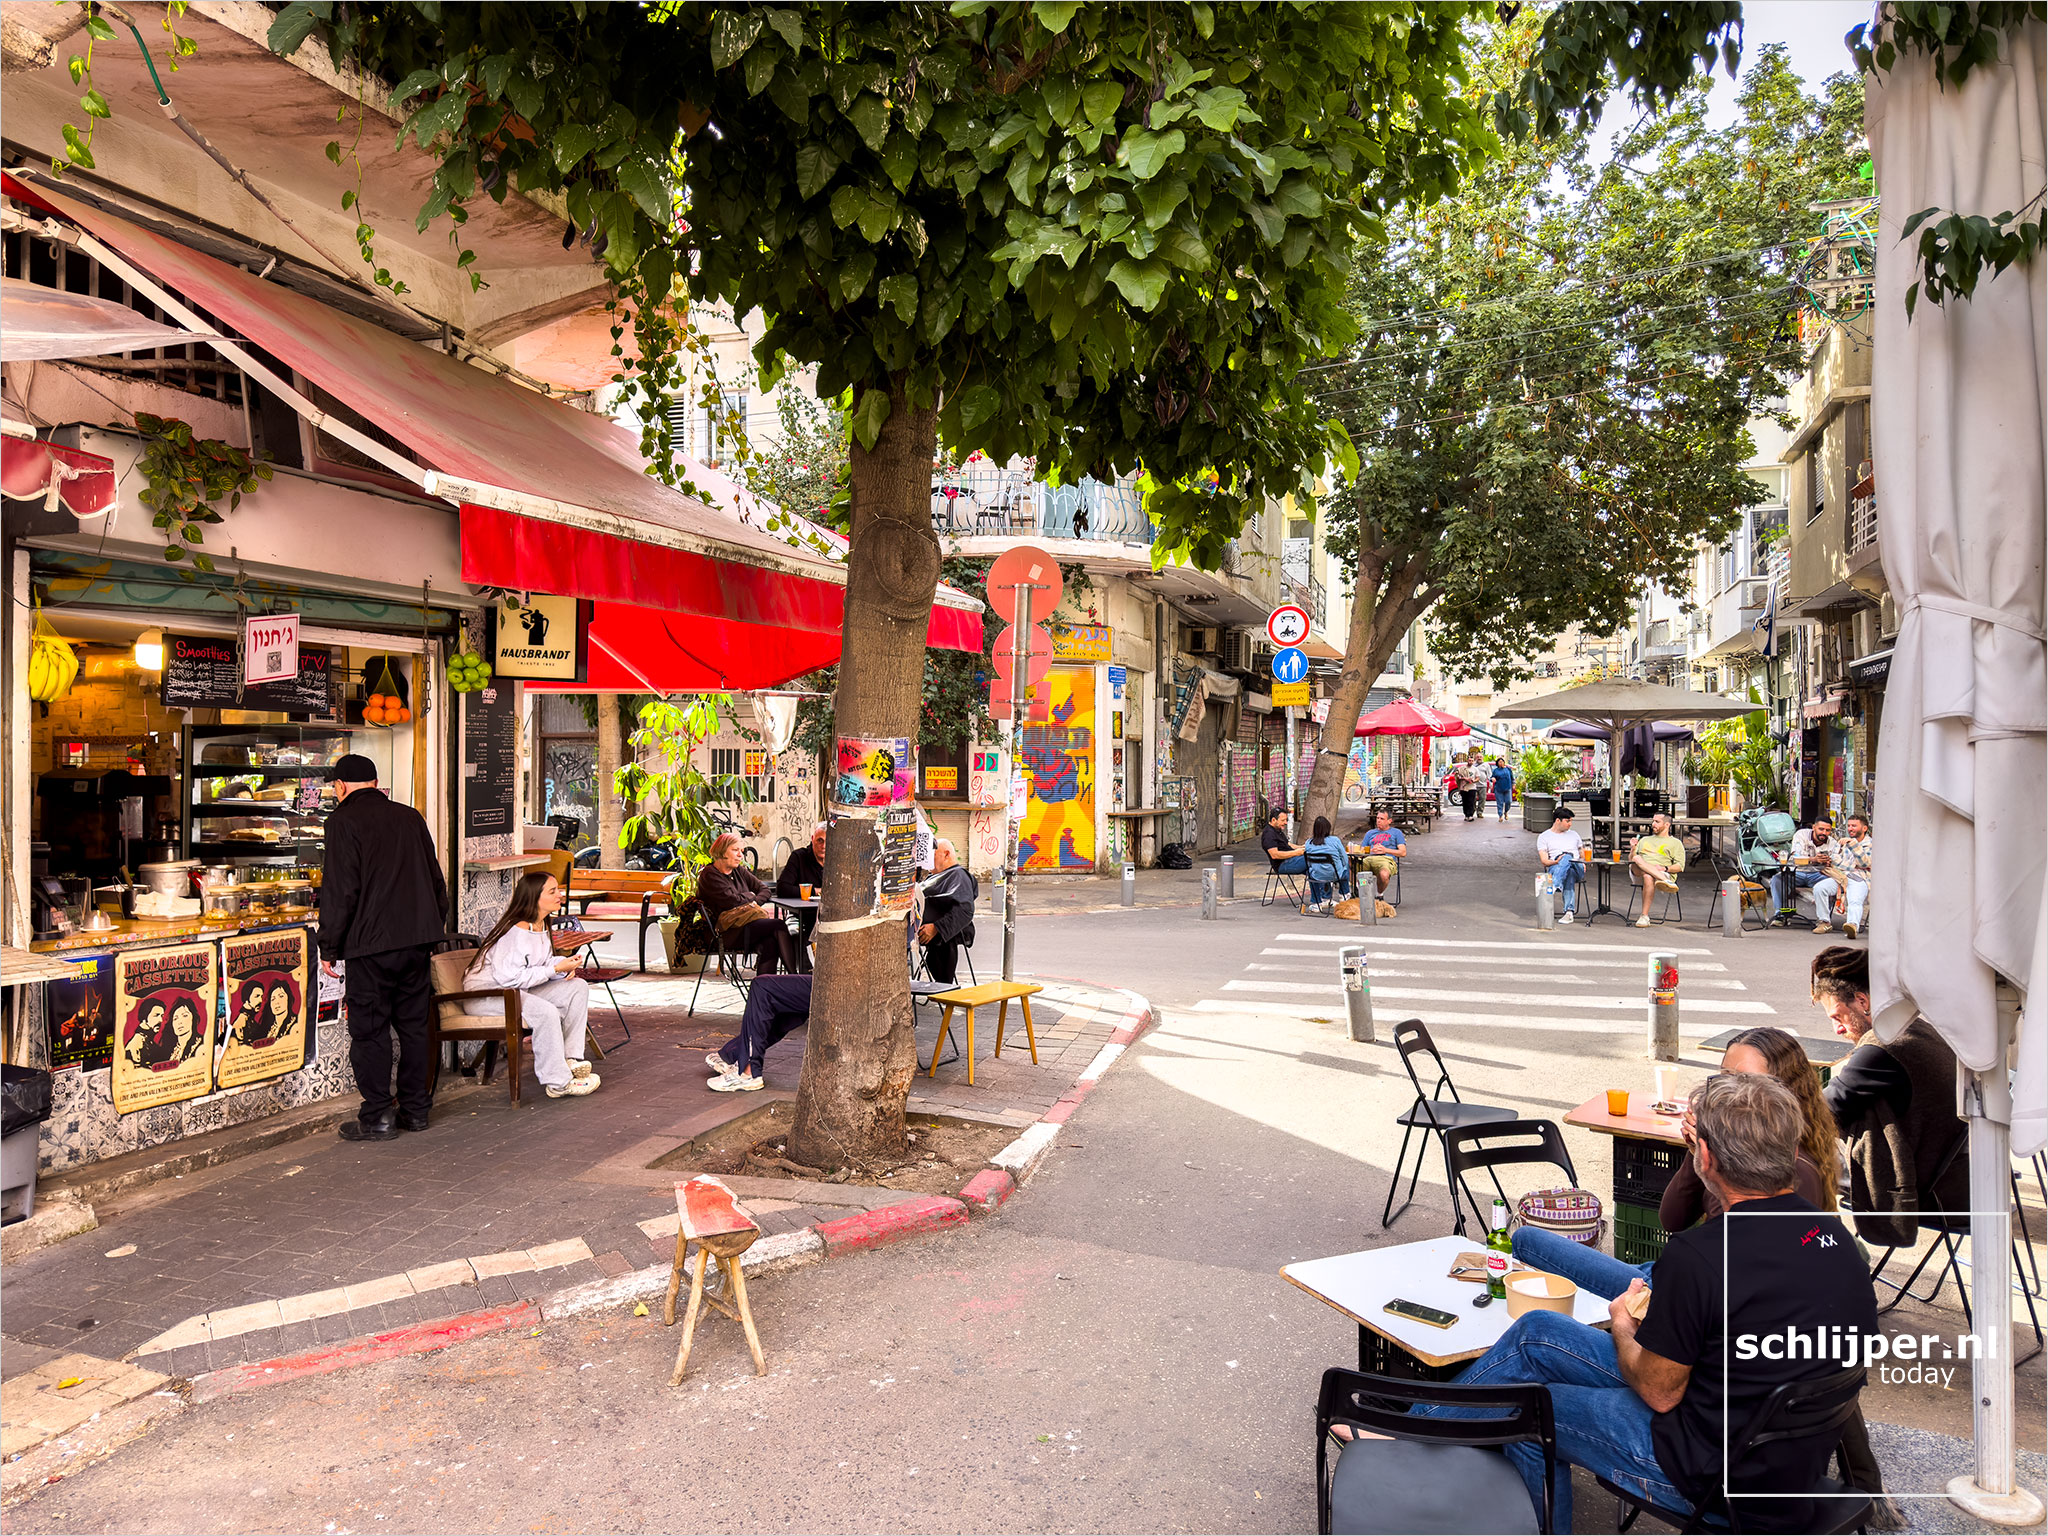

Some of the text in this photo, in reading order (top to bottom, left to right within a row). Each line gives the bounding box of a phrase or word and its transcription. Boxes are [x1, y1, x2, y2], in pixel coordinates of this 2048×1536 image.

[500, 648, 571, 660] HAUSBRANDT
[926, 769, 956, 777] להשכרה
[227, 936, 301, 961] INGLORIOUS
[123, 951, 210, 979] INGLORIOUS
[227, 952, 301, 978] CASSETTES
[124, 968, 210, 995] CASSETTES
